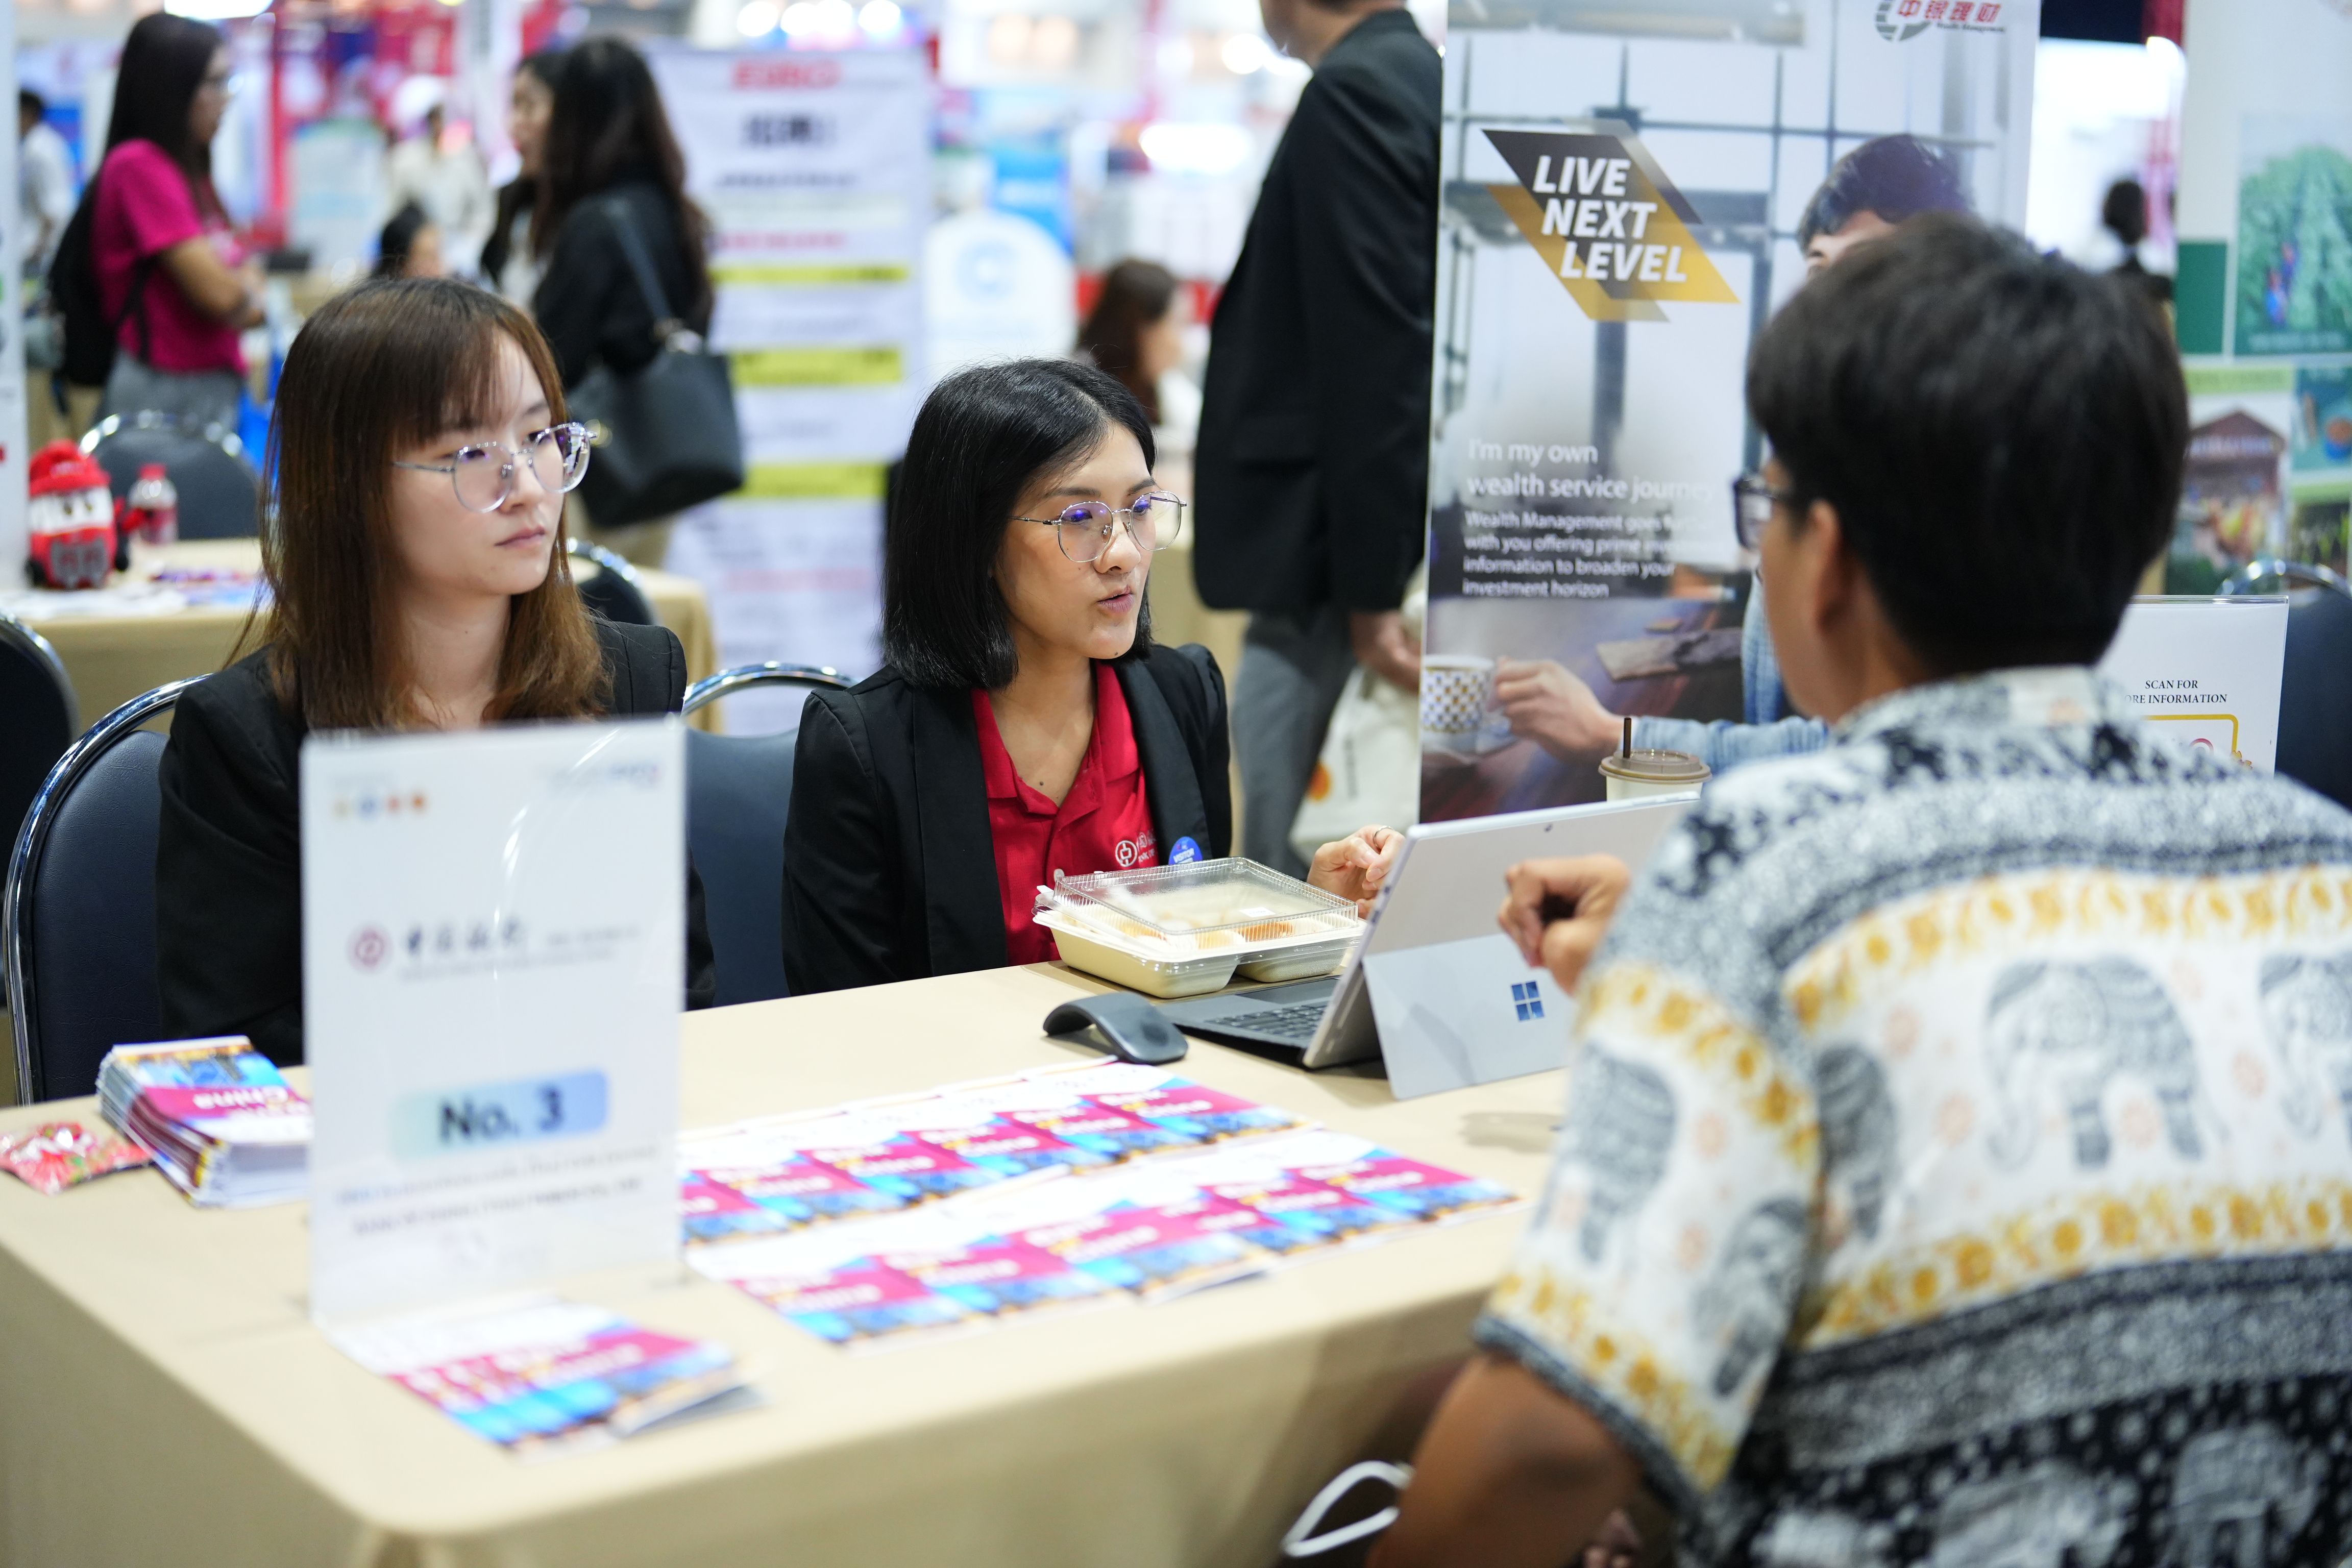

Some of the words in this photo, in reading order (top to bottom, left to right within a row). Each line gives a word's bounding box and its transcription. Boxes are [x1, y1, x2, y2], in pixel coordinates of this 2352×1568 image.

[1533, 155, 1630, 196] LIVE
[1541, 200, 1657, 238] NEXT
[1559, 243, 1687, 283] LEVEL
[1469, 439, 1502, 459] I'm
[1508, 442, 1543, 467] my
[1548, 444, 1598, 463] own
[1467, 473, 1544, 496] wealth
[1549, 475, 1628, 499] service
[1464, 511, 1520, 528] Wealth
[1522, 511, 1623, 534] Management
[1464, 534, 1500, 550] with
[1501, 537, 1532, 555] you
[1533, 534, 1595, 556] offering
[1463, 555, 1554, 574] information
[1556, 558, 1574, 575] to
[1575, 557, 1639, 576] broaden
[1640, 561, 1675, 580] your
[1462, 578, 1548, 597] investment
[1550, 579, 1609, 598] horizon
[2145, 679, 2174, 690] SCAN
[2176, 679, 2199, 690] FOR
[2124, 694, 2146, 704] ORE
[2148, 694, 2228, 704] INFORMATION
[439, 1095, 521, 1145] No.
[537, 1083, 565, 1133] 3
